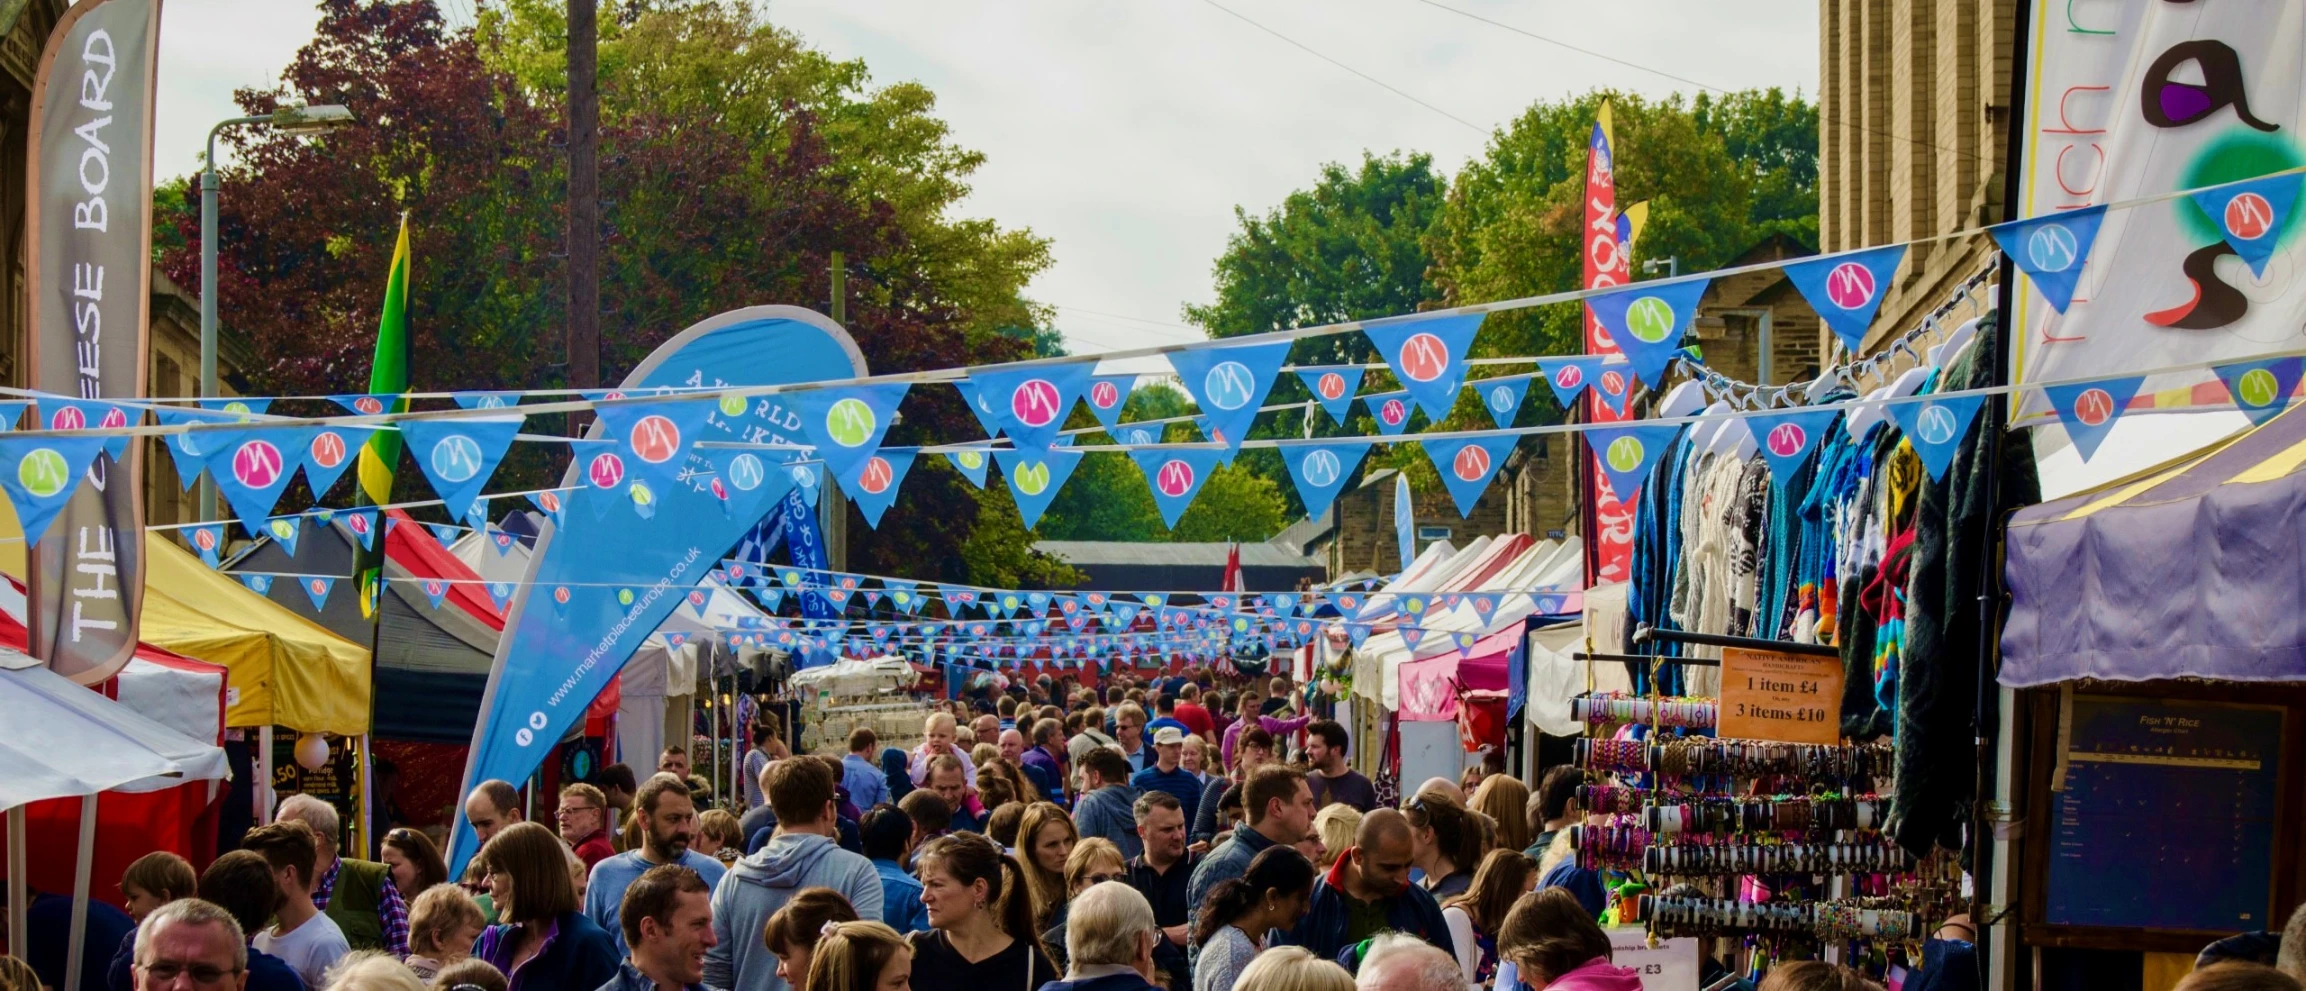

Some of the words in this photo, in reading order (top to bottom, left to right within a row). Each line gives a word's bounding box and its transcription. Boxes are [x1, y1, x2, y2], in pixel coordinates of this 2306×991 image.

[75, 28, 116, 233] BOARD
[74, 263, 106, 492] CEESE
[72, 525, 117, 642] THE
[548, 546, 702, 707] www.marketplaceeurope.co.uk
[1736, 703, 1745, 717] 3
[1750, 704, 1792, 721] items
[1797, 707, 1825, 723] £10
[1747, 677, 1753, 690] 1
[1760, 678, 1794, 693] item
[1800, 680, 1818, 694] £4
[1612, 944, 1636, 952] ndship
[1645, 963, 1662, 975] £3
